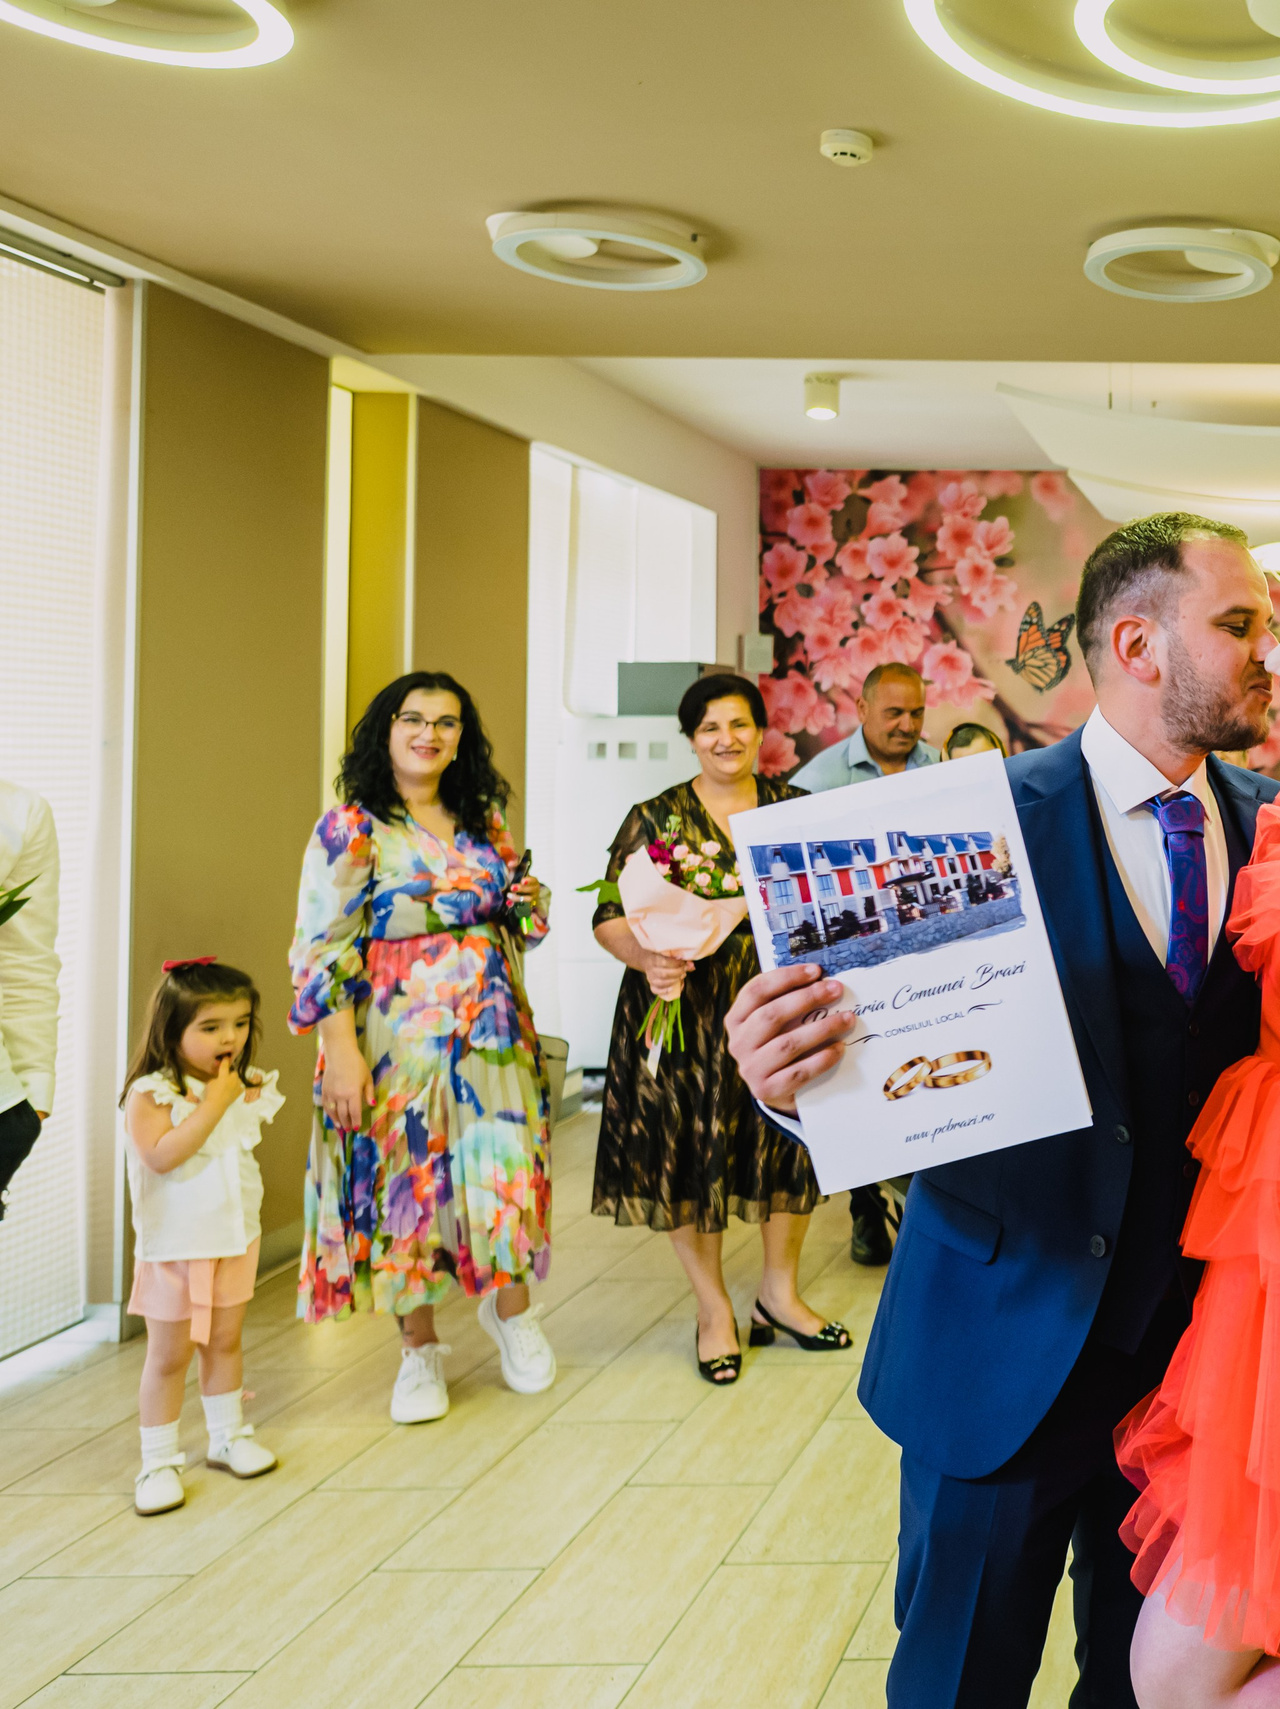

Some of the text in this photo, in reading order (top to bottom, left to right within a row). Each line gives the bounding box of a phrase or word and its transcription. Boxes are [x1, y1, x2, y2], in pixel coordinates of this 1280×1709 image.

[892, 976, 966, 1010] Comunei
[970, 961, 1027, 990] Brazi
[884, 1011, 965, 1038] CONSILIUL LOCAL
[905, 1113, 995, 1143] www.pcbrazi.ro
